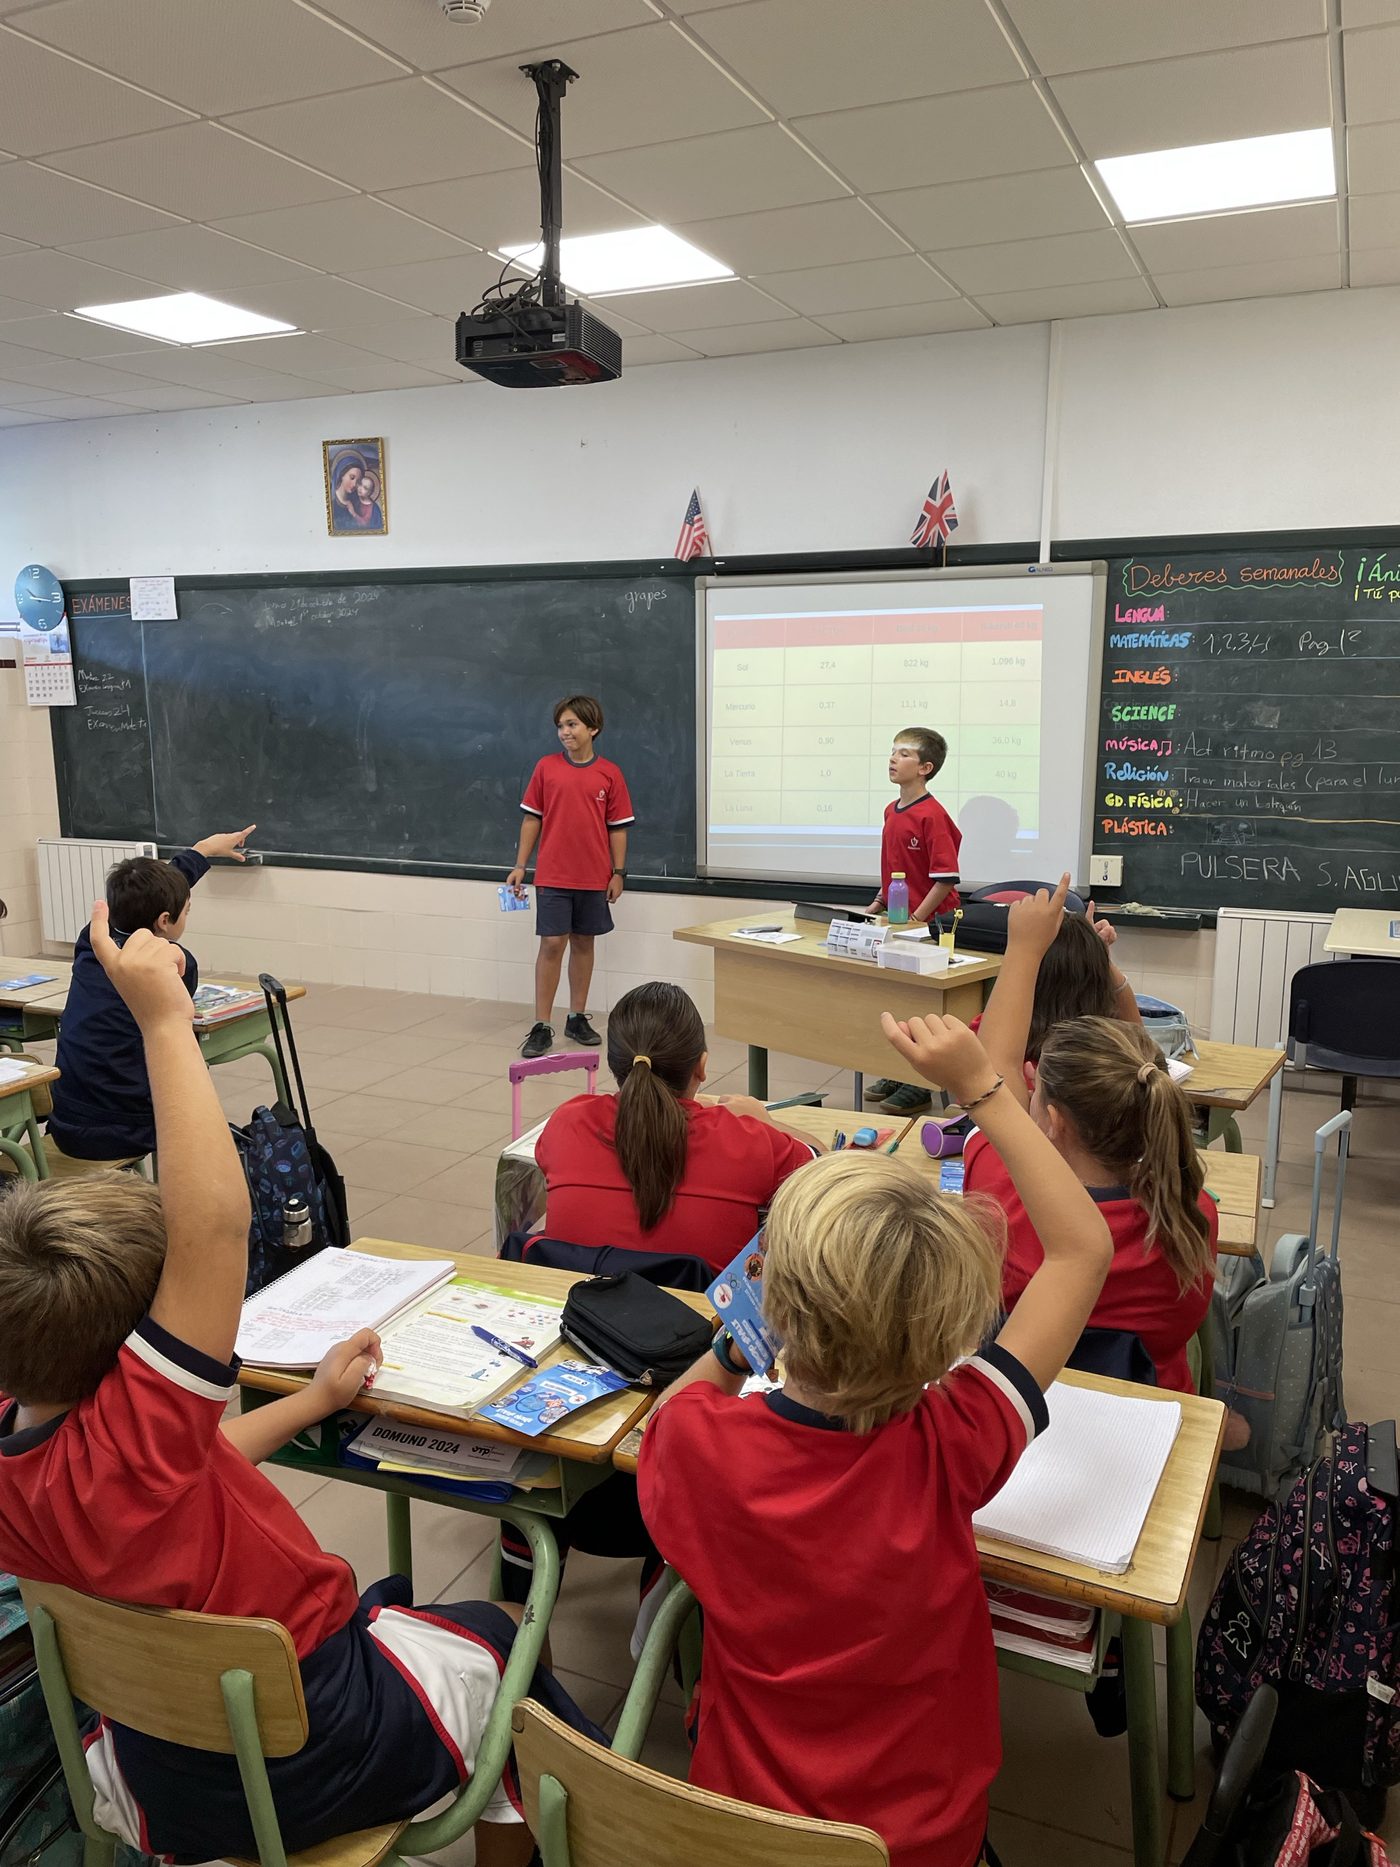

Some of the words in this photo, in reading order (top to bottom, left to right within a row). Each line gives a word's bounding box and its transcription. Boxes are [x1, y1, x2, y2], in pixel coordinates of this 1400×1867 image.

[1130, 564, 1228, 591] Deberes
[1240, 557, 1339, 583] semanales
[624, 589, 668, 614] grapes
[1311, 738, 1338, 760] 13
[1180, 851, 1301, 883] PULSERA
[1343, 865, 1400, 892] AGU
[371, 1426, 428, 1448] DOMUND
[427, 1438, 461, 1455] 2024
